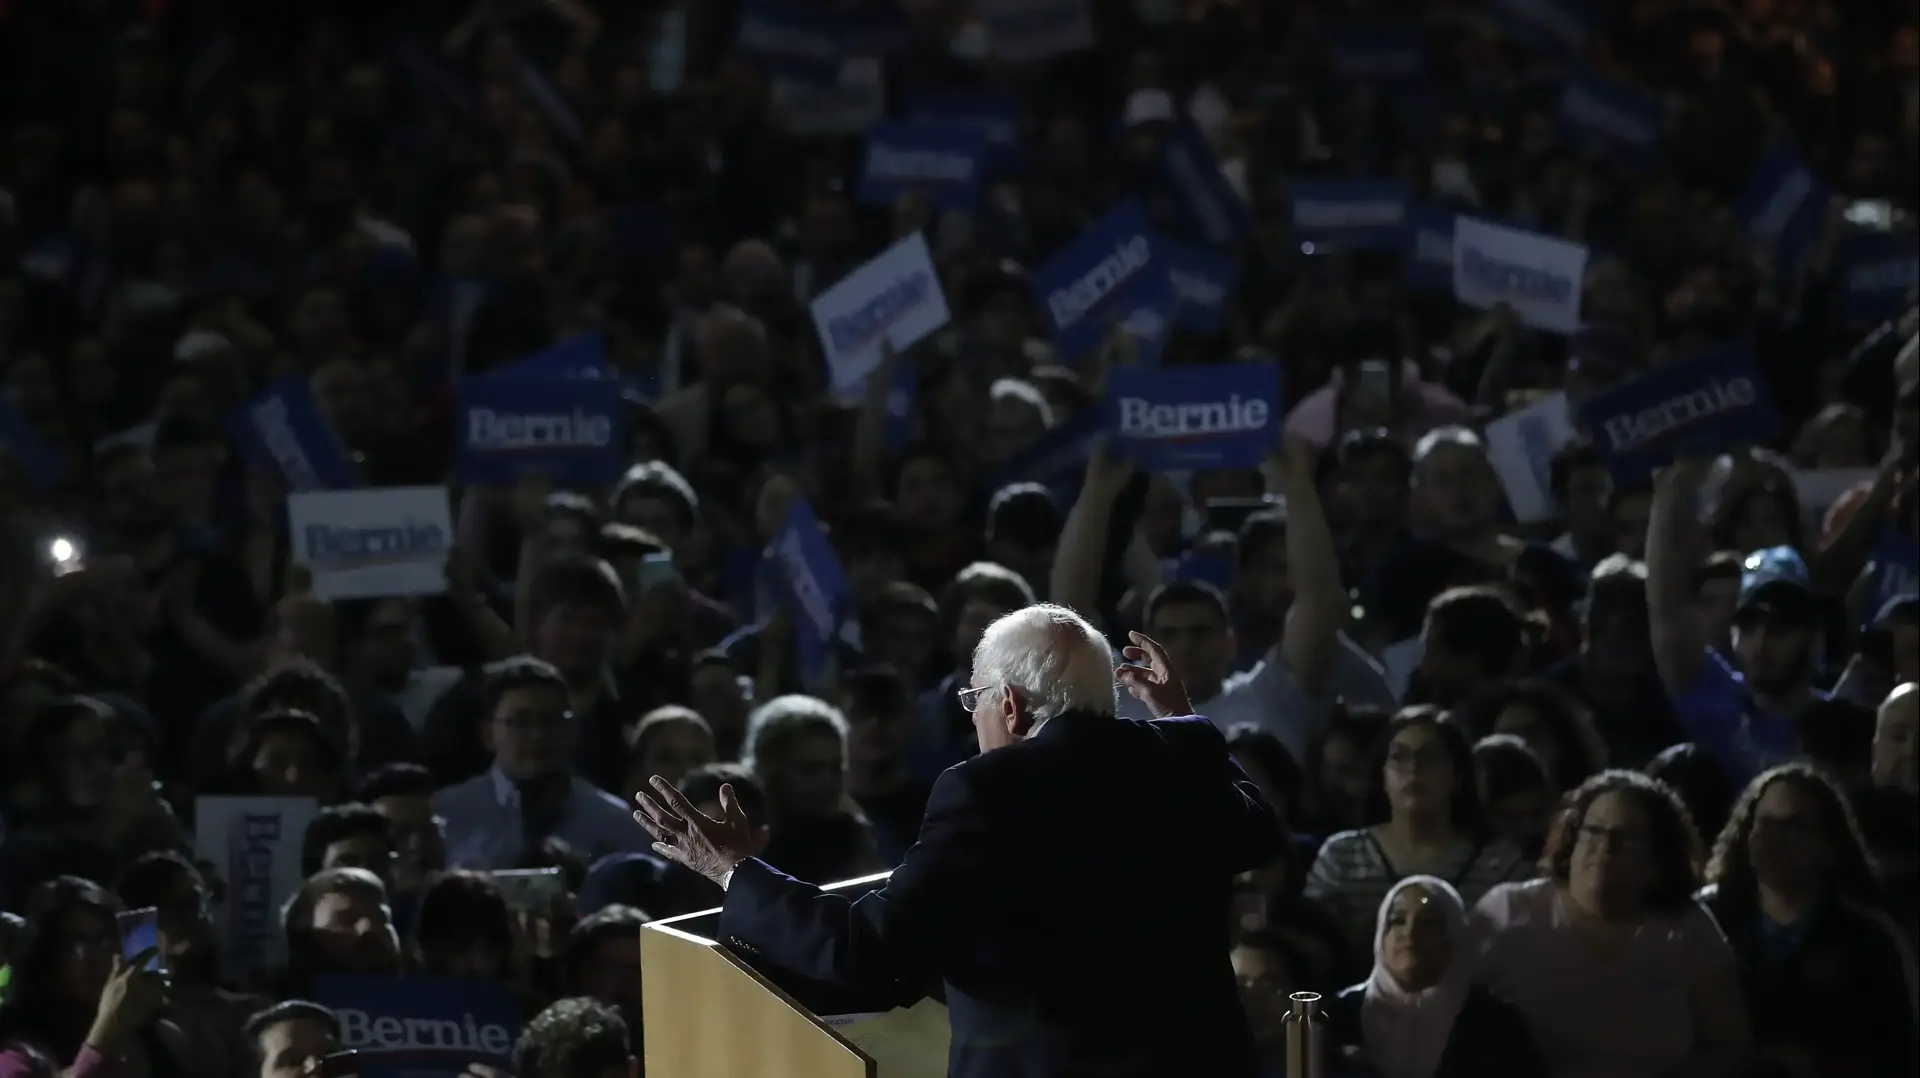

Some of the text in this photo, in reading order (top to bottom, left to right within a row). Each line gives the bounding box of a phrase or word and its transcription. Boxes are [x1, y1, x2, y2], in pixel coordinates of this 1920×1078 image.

[1047, 234, 1150, 329] Bernie
[467, 404, 612, 449] Bernie
[1118, 394, 1268, 436] Bernie
[1604, 376, 1756, 452] Bernie
[305, 515, 445, 559] Bernie
[336, 1008, 515, 1055] Bernie
